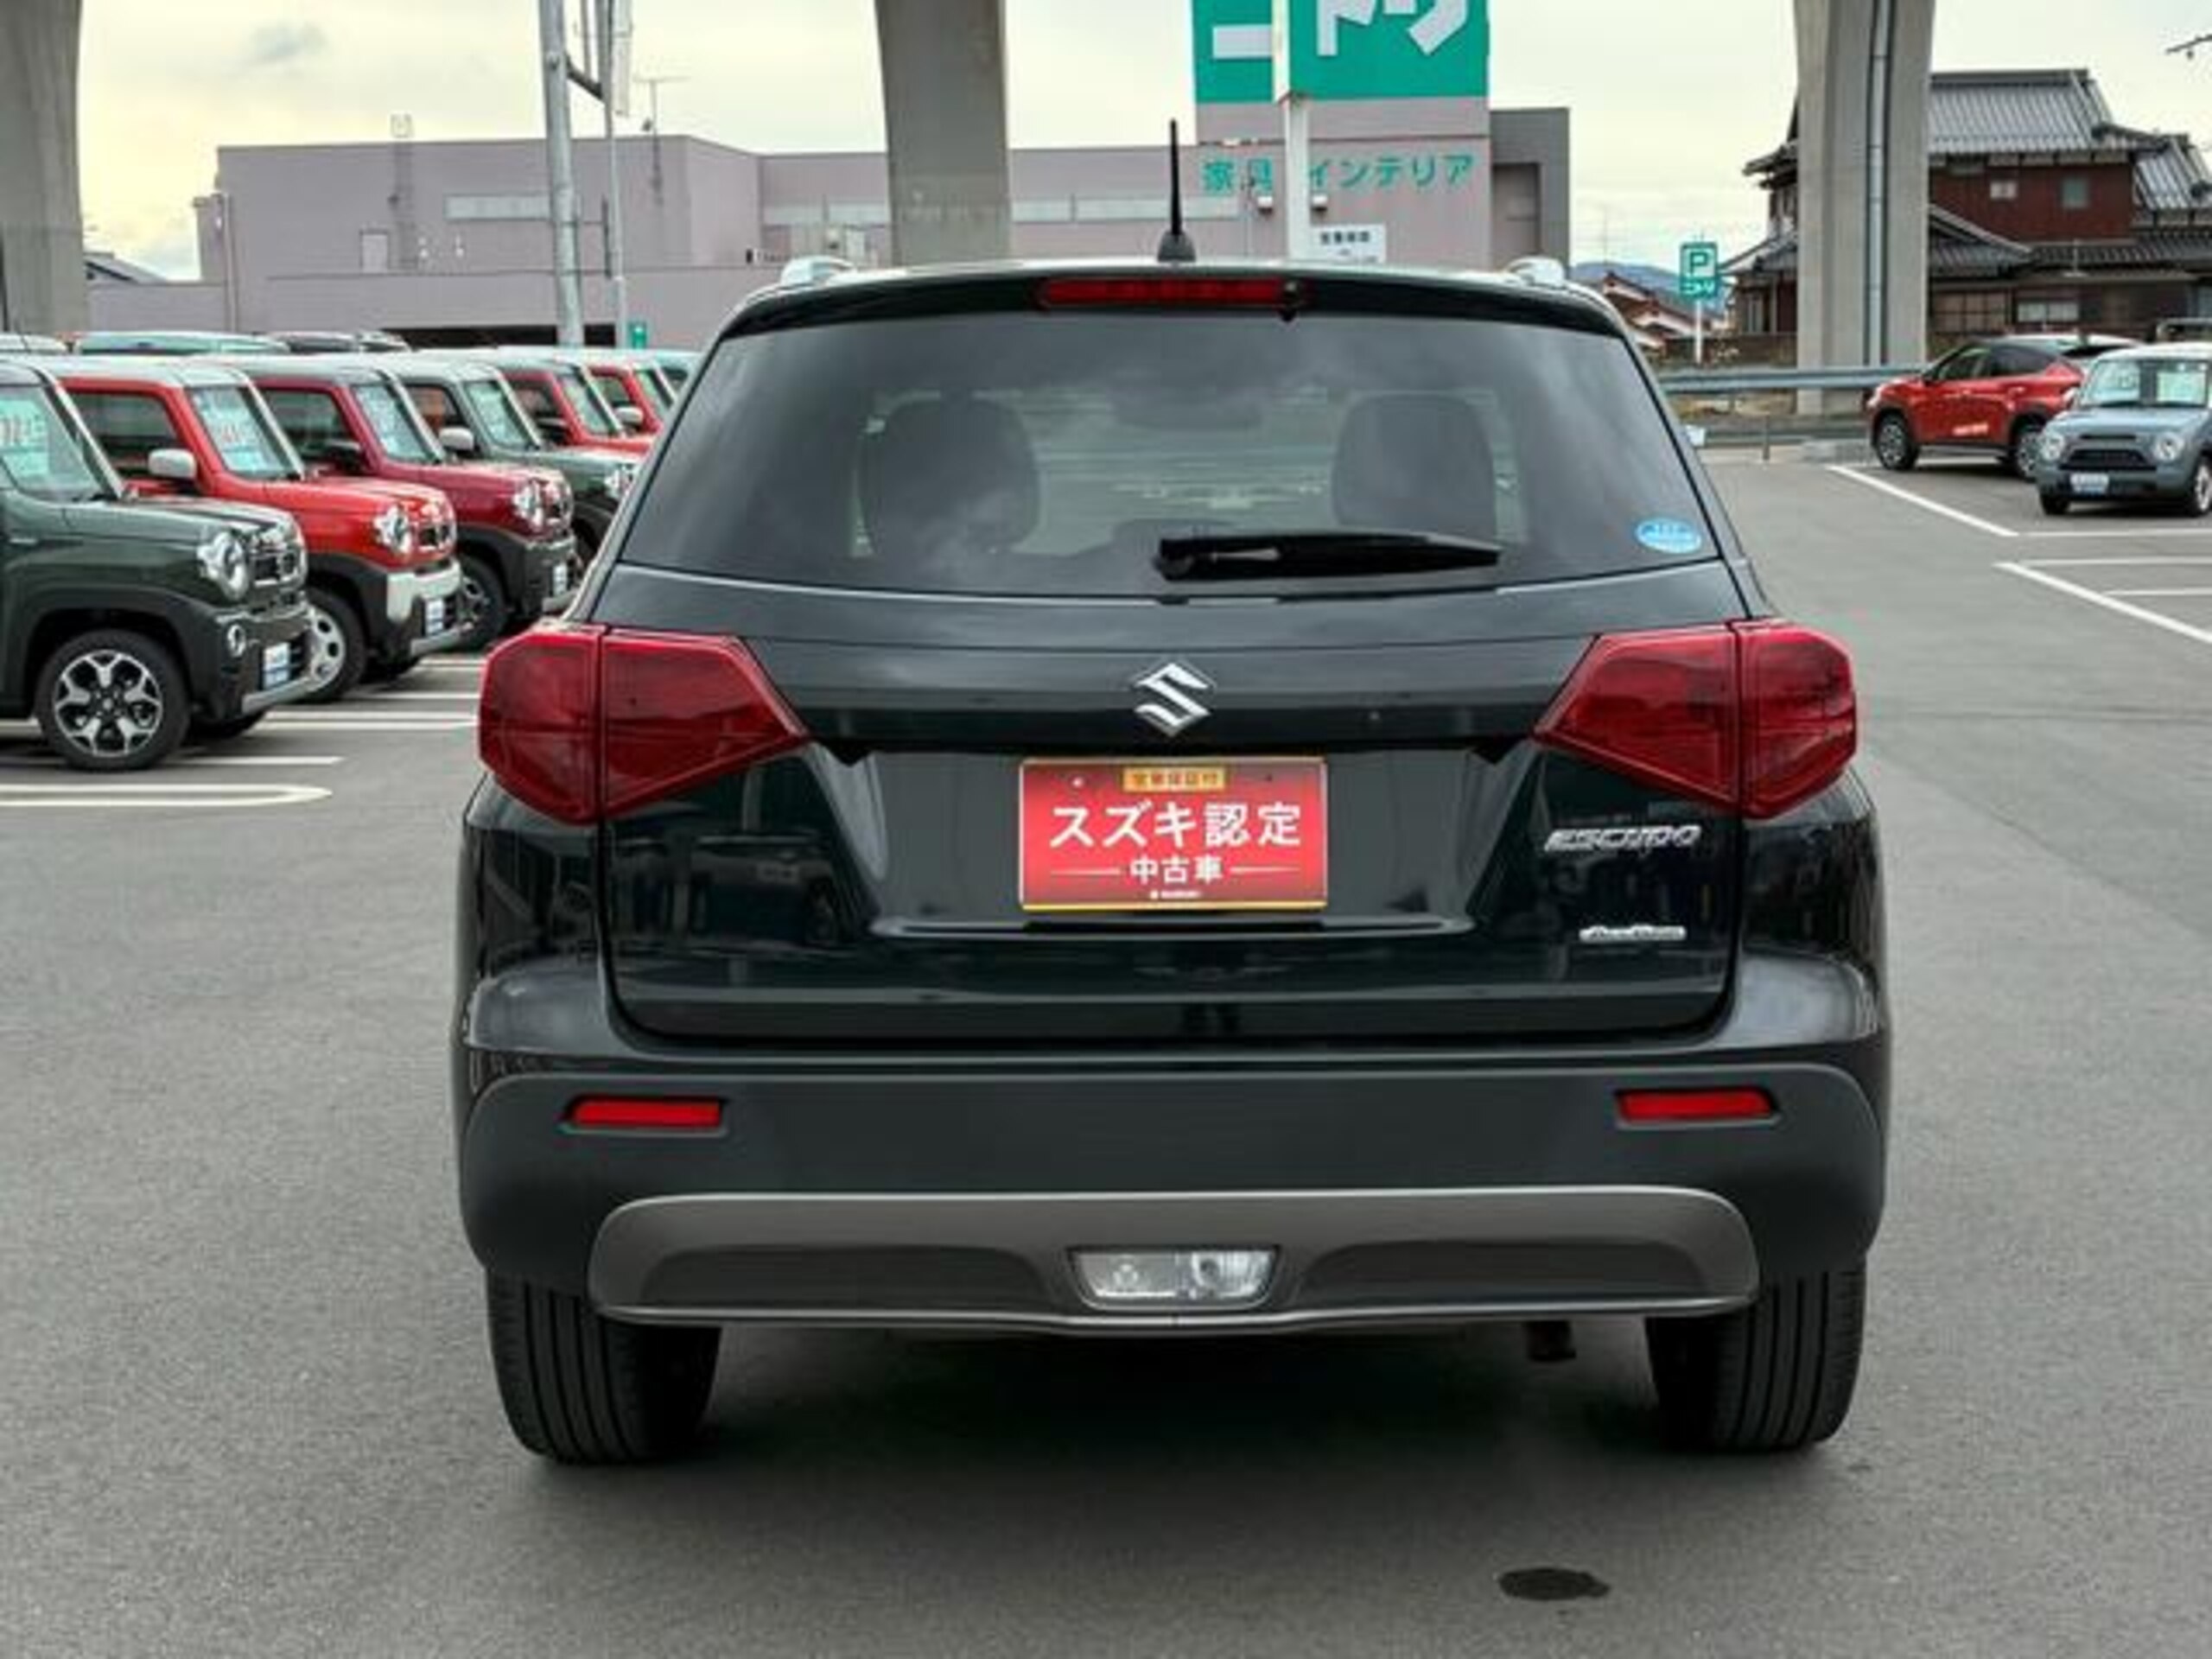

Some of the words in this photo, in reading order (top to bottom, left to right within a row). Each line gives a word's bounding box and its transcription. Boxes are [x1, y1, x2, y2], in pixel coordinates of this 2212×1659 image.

[1689, 251, 1708, 275] P
[1050, 800, 1301, 849] スズキ認定
[1129, 855, 1224, 885] 中古車
